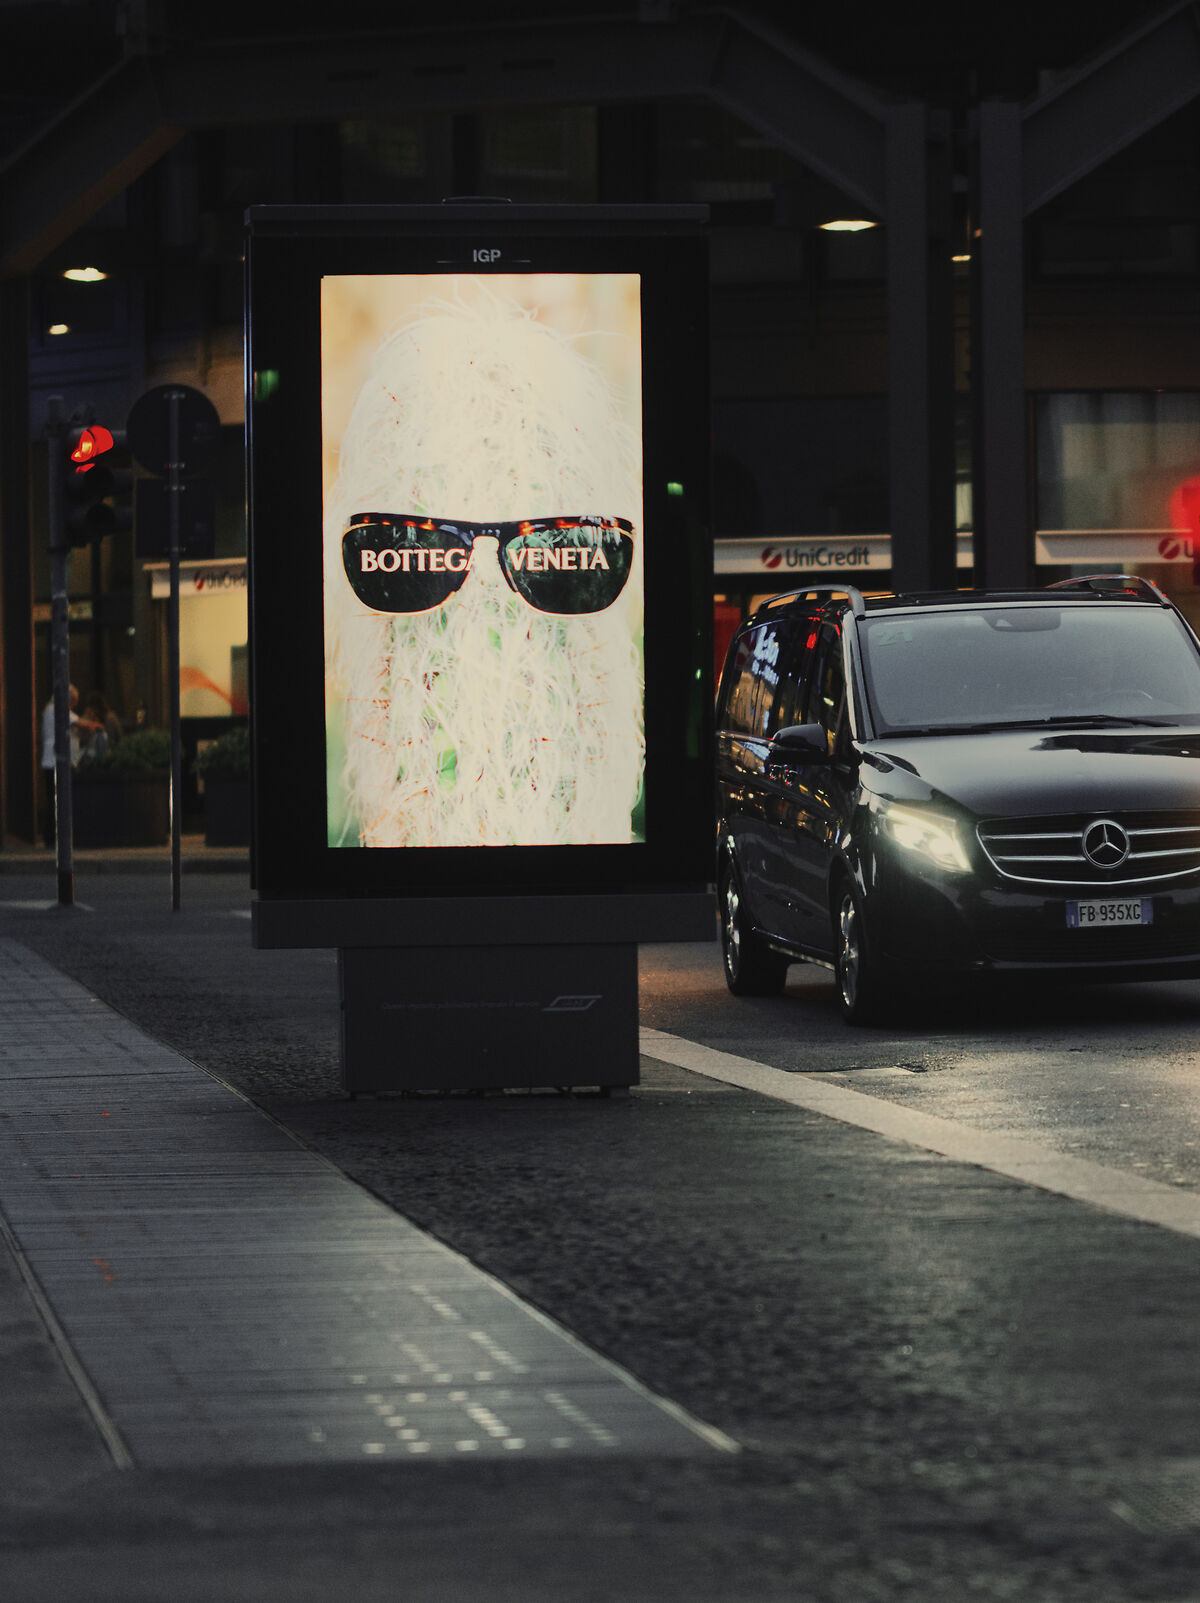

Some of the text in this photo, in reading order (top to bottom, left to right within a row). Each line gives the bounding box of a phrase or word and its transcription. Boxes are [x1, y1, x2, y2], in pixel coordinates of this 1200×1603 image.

[472, 248, 502, 263] IGP
[508, 546, 611, 571] VENETA
[785, 546, 870, 568] UniCredit
